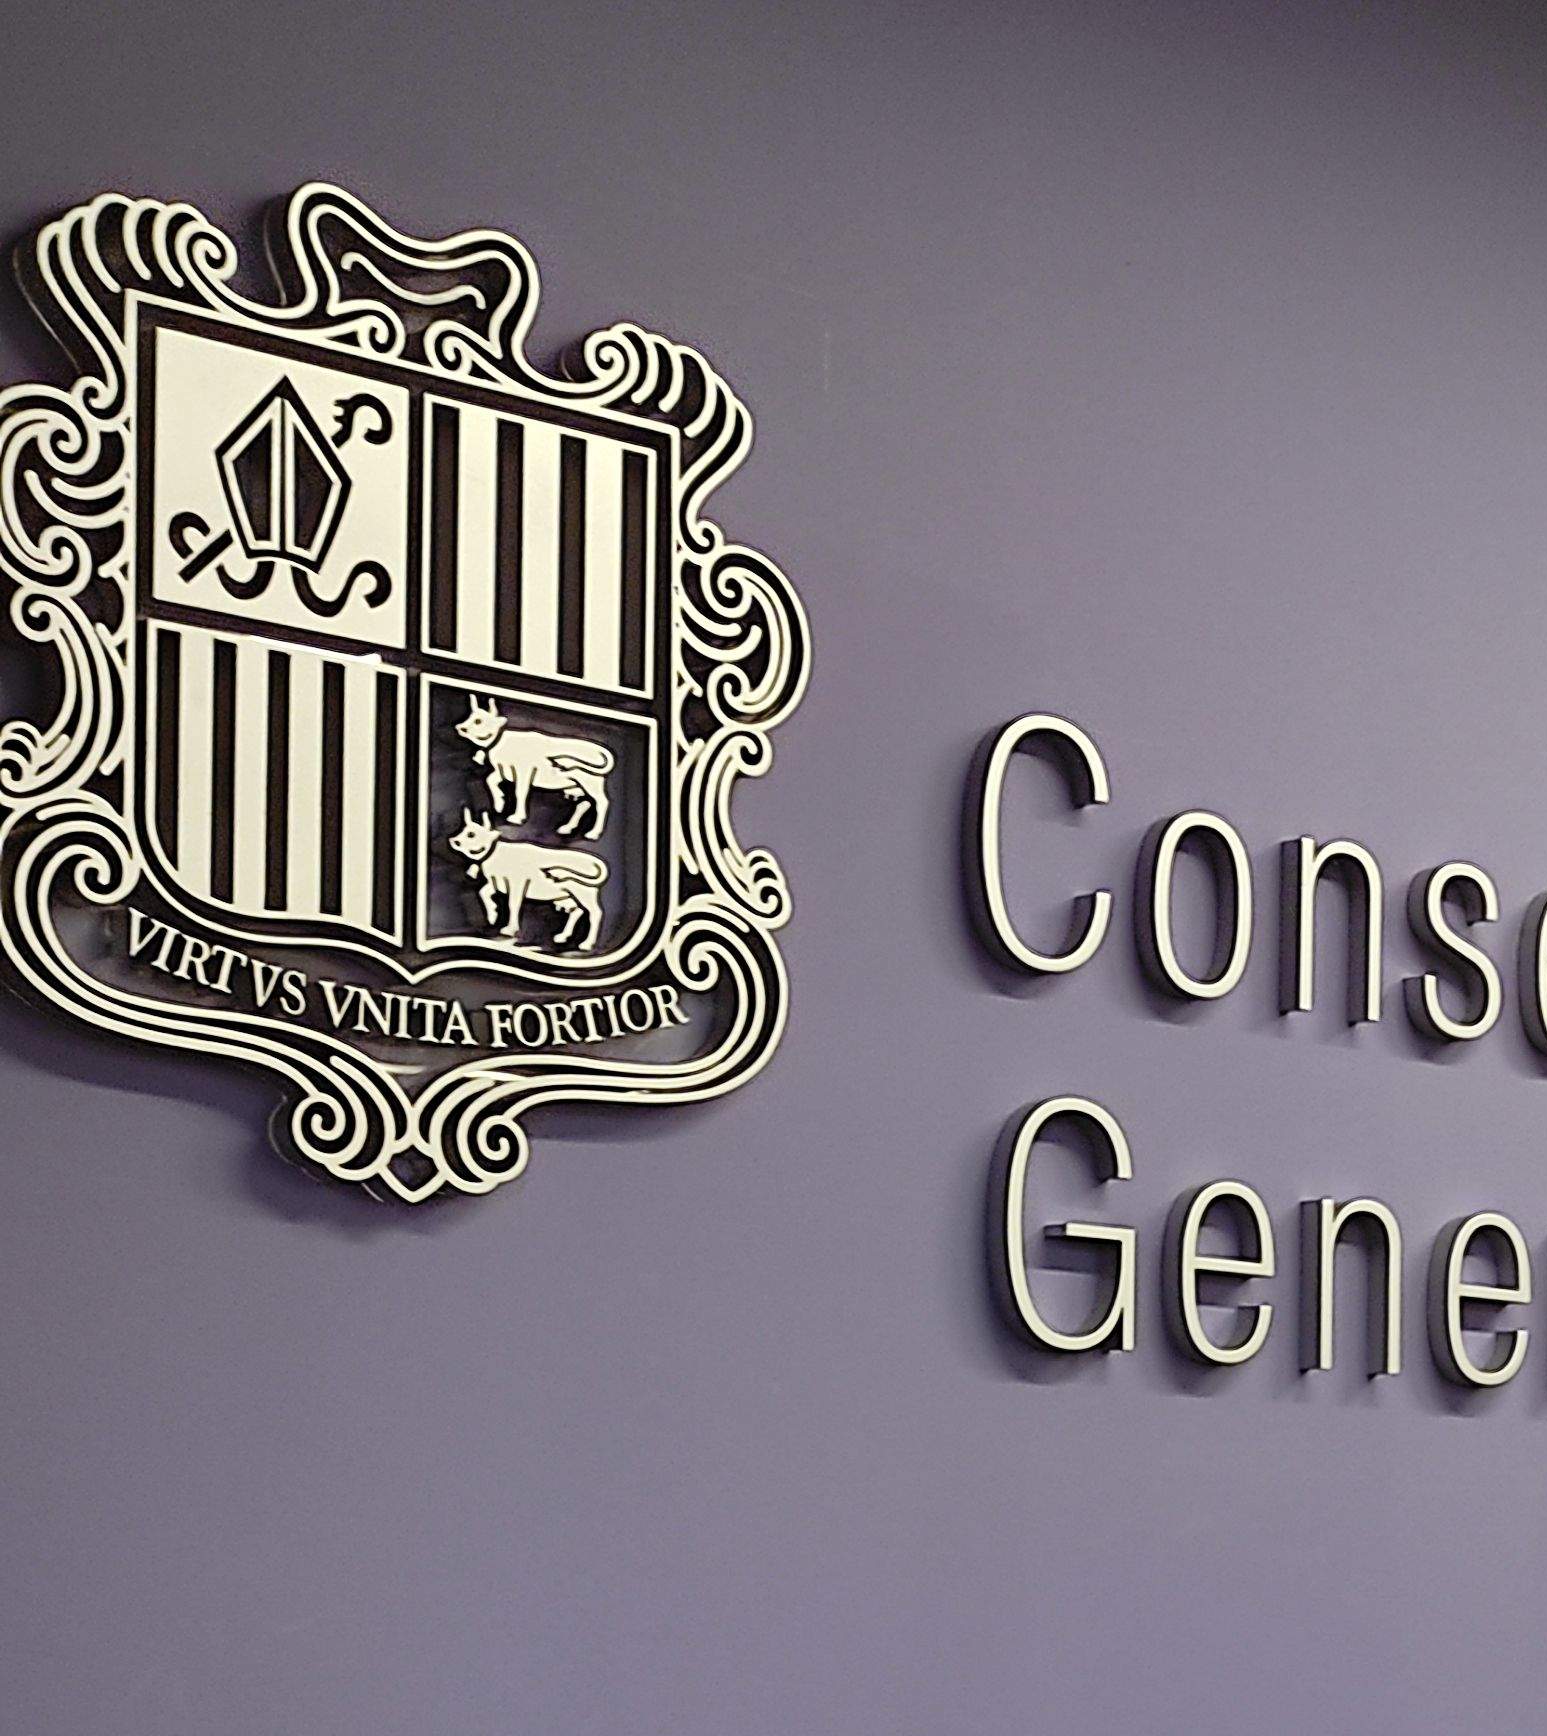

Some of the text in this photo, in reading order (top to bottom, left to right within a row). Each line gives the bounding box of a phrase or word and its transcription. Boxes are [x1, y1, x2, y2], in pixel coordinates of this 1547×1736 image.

[126, 907, 691, 1049] VIRTVS VNITA FORTIOR
